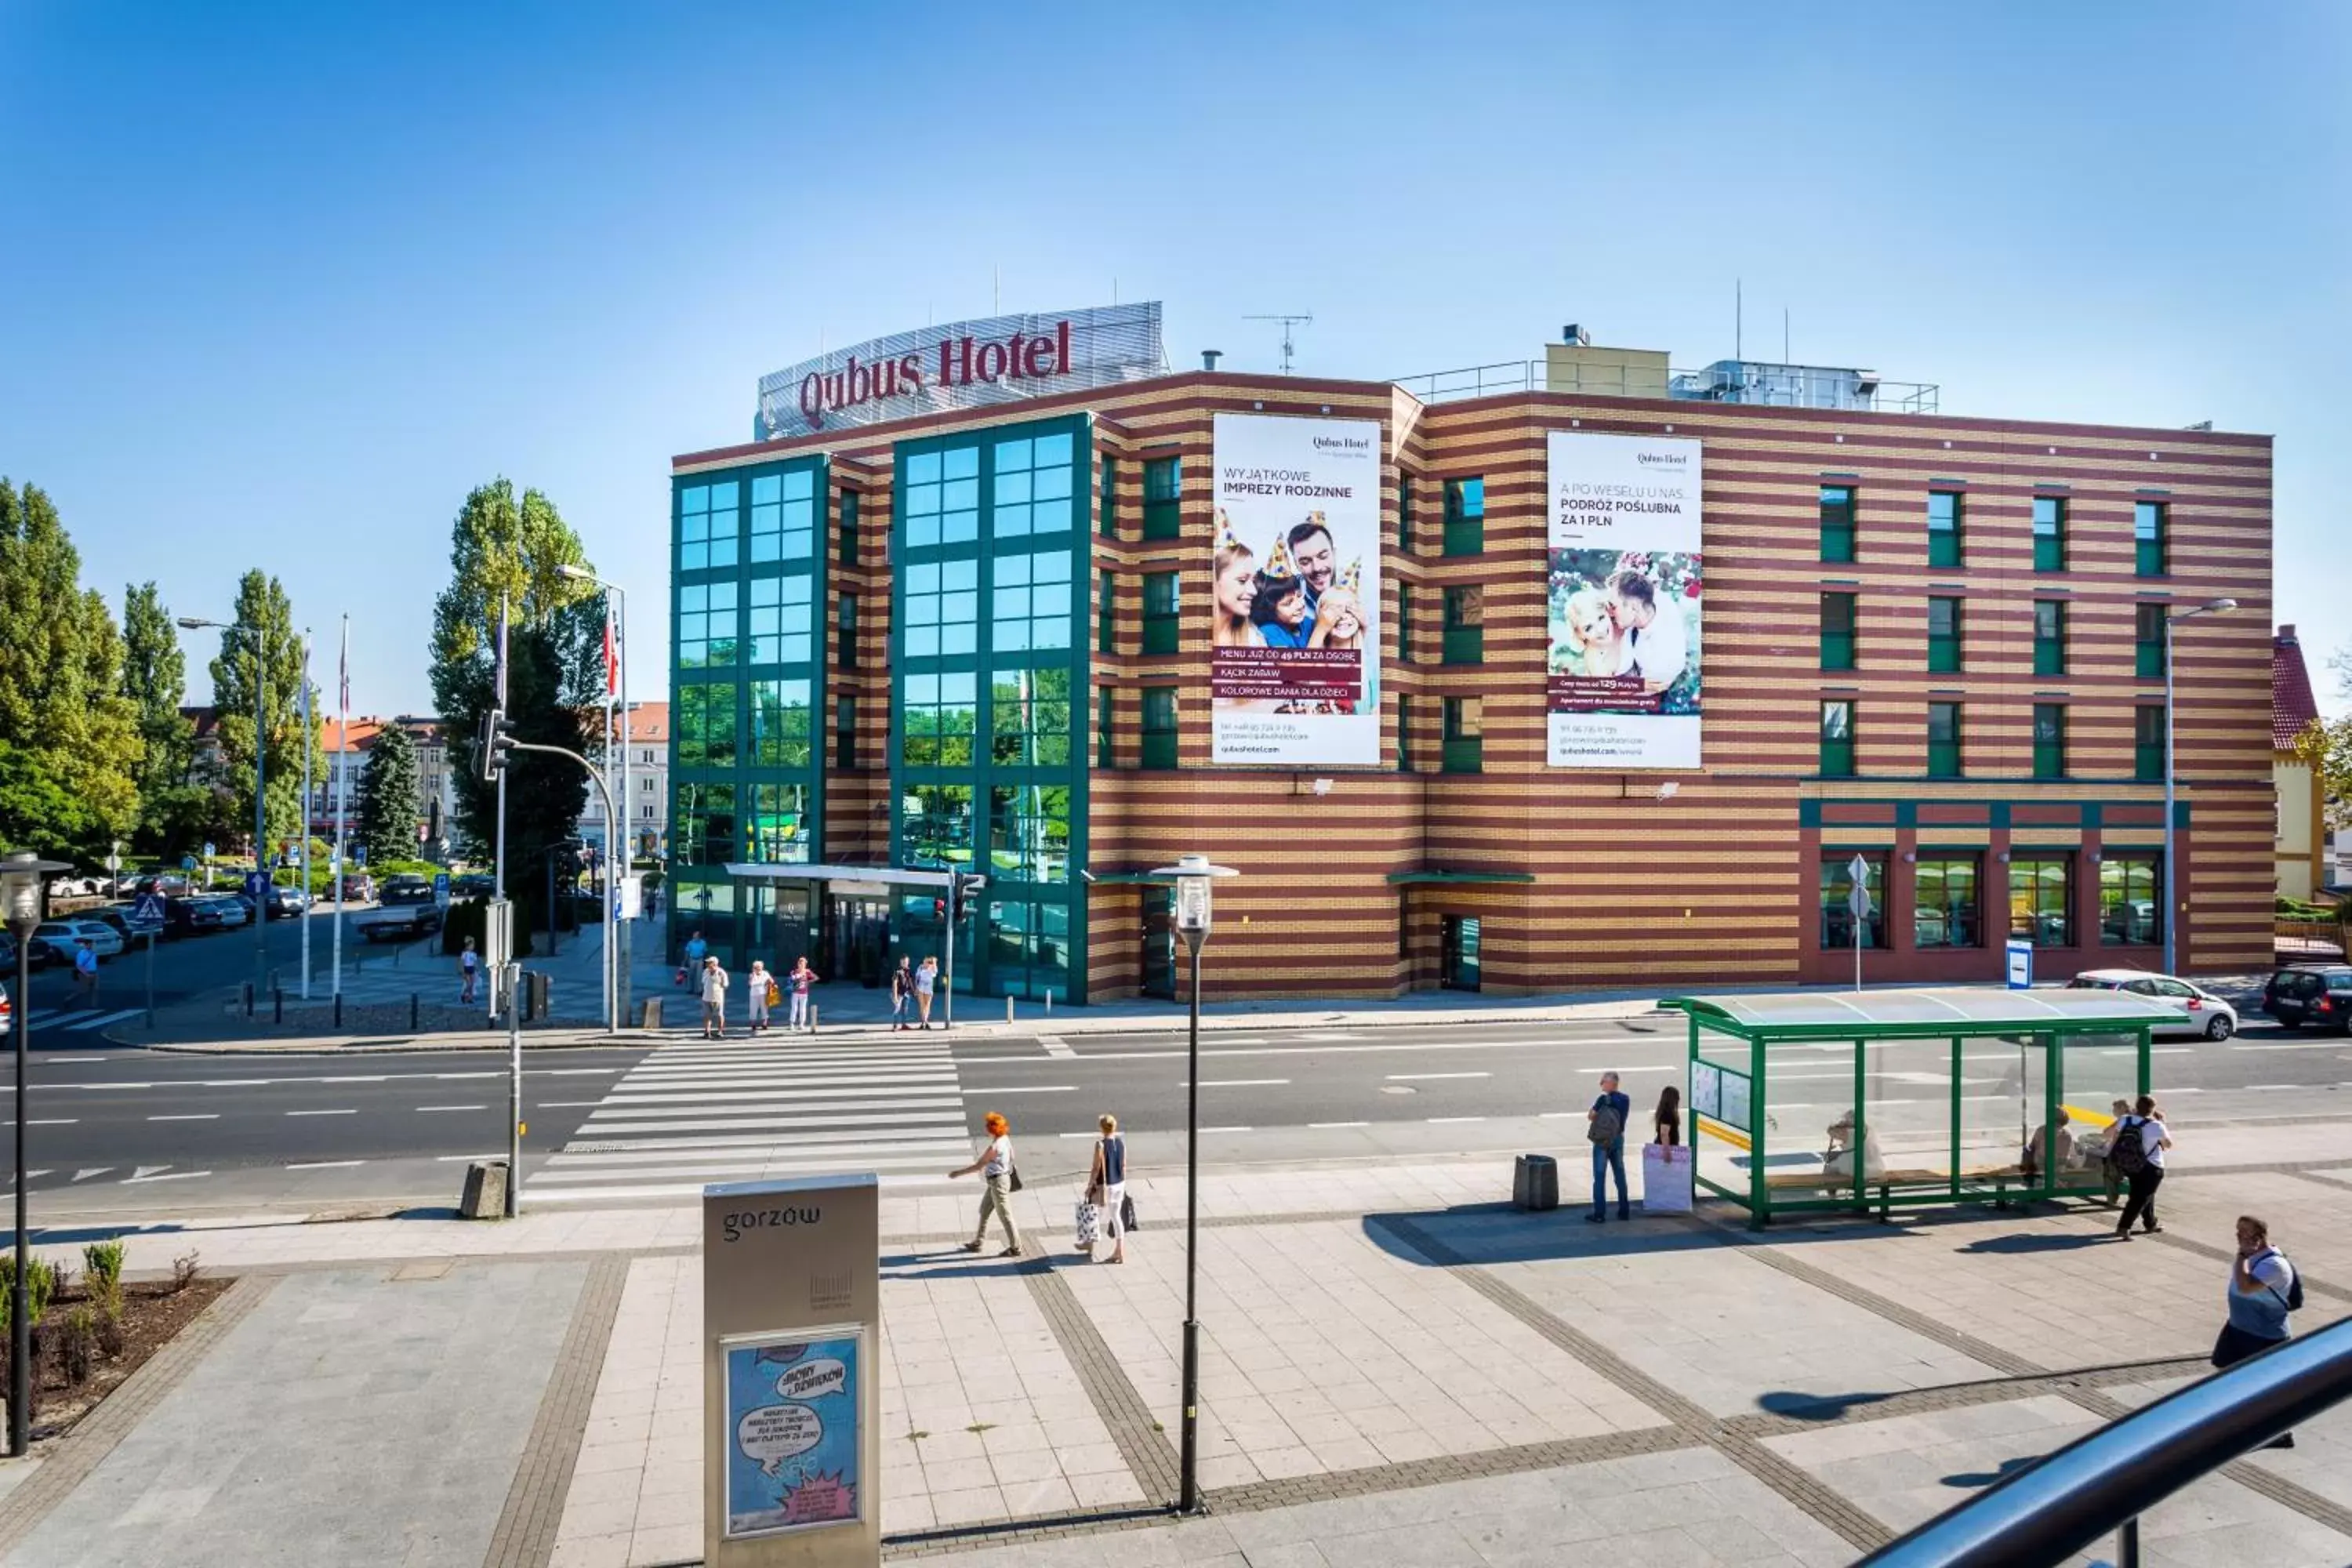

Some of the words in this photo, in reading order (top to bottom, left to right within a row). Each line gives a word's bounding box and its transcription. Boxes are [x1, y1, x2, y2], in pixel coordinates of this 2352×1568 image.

[800, 354, 920, 430] Qubus
[938, 320, 1071, 387] Hotel
[1224, 467, 1311, 482] WYJĄTKOWE
[1224, 482, 1281, 495] IMPREZY
[1285, 485, 1352, 498] RODZINNE
[1561, 483, 1569, 493] A
[1572, 484, 1591, 495] PO
[1594, 485, 1645, 498] WESELU
[1647, 487, 1657, 498] U
[1561, 498, 1613, 511] PODRÓŻ
[1616, 500, 1682, 514] POŚLUBNA
[1561, 514, 1577, 525] ZA
[1581, 514, 1584, 525] 1
[1588, 515, 1613, 526] PLN
[1221, 649, 1246, 659] MENU
[1266, 651, 1279, 659] OD
[1280, 652, 1293, 660] 49
[1294, 651, 1311, 659] PLN
[1600, 680, 1617, 688] 129
[724, 1207, 820, 1243] gorzów
